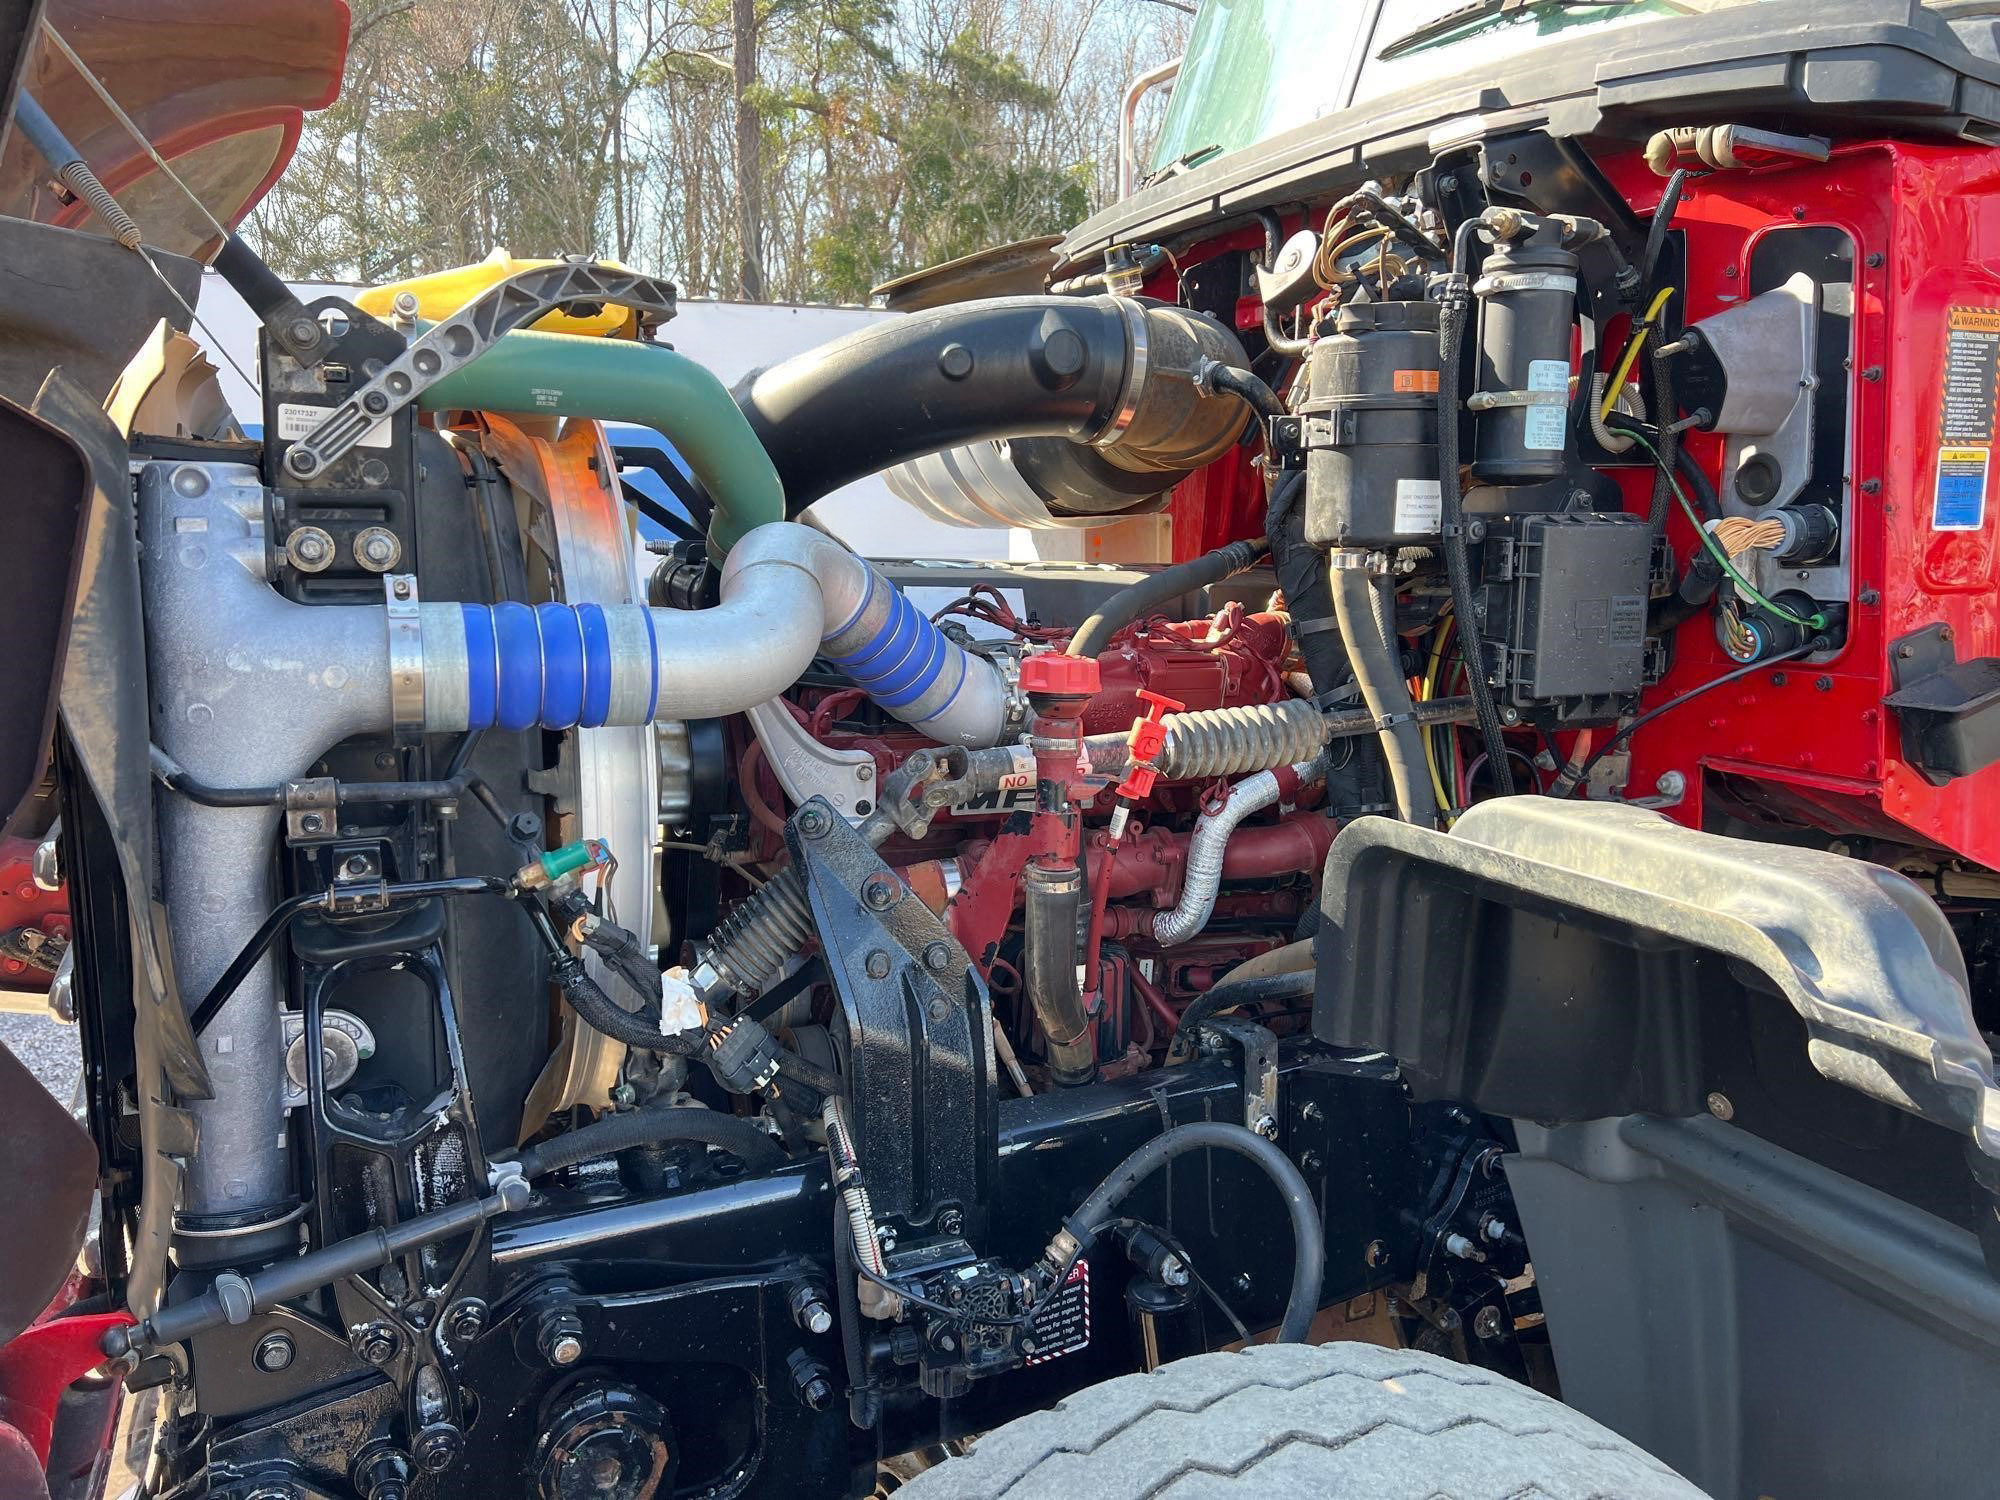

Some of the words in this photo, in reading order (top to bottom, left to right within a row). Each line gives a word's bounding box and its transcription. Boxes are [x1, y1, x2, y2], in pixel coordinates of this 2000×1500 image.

[1962, 316, 2000, 328] WARNING
[1964, 332, 1984, 340] PERSONAL
[284, 408, 317, 416] 23017327
[1004, 776, 1028, 788] NO
[1062, 1285, 1081, 1296] personal
